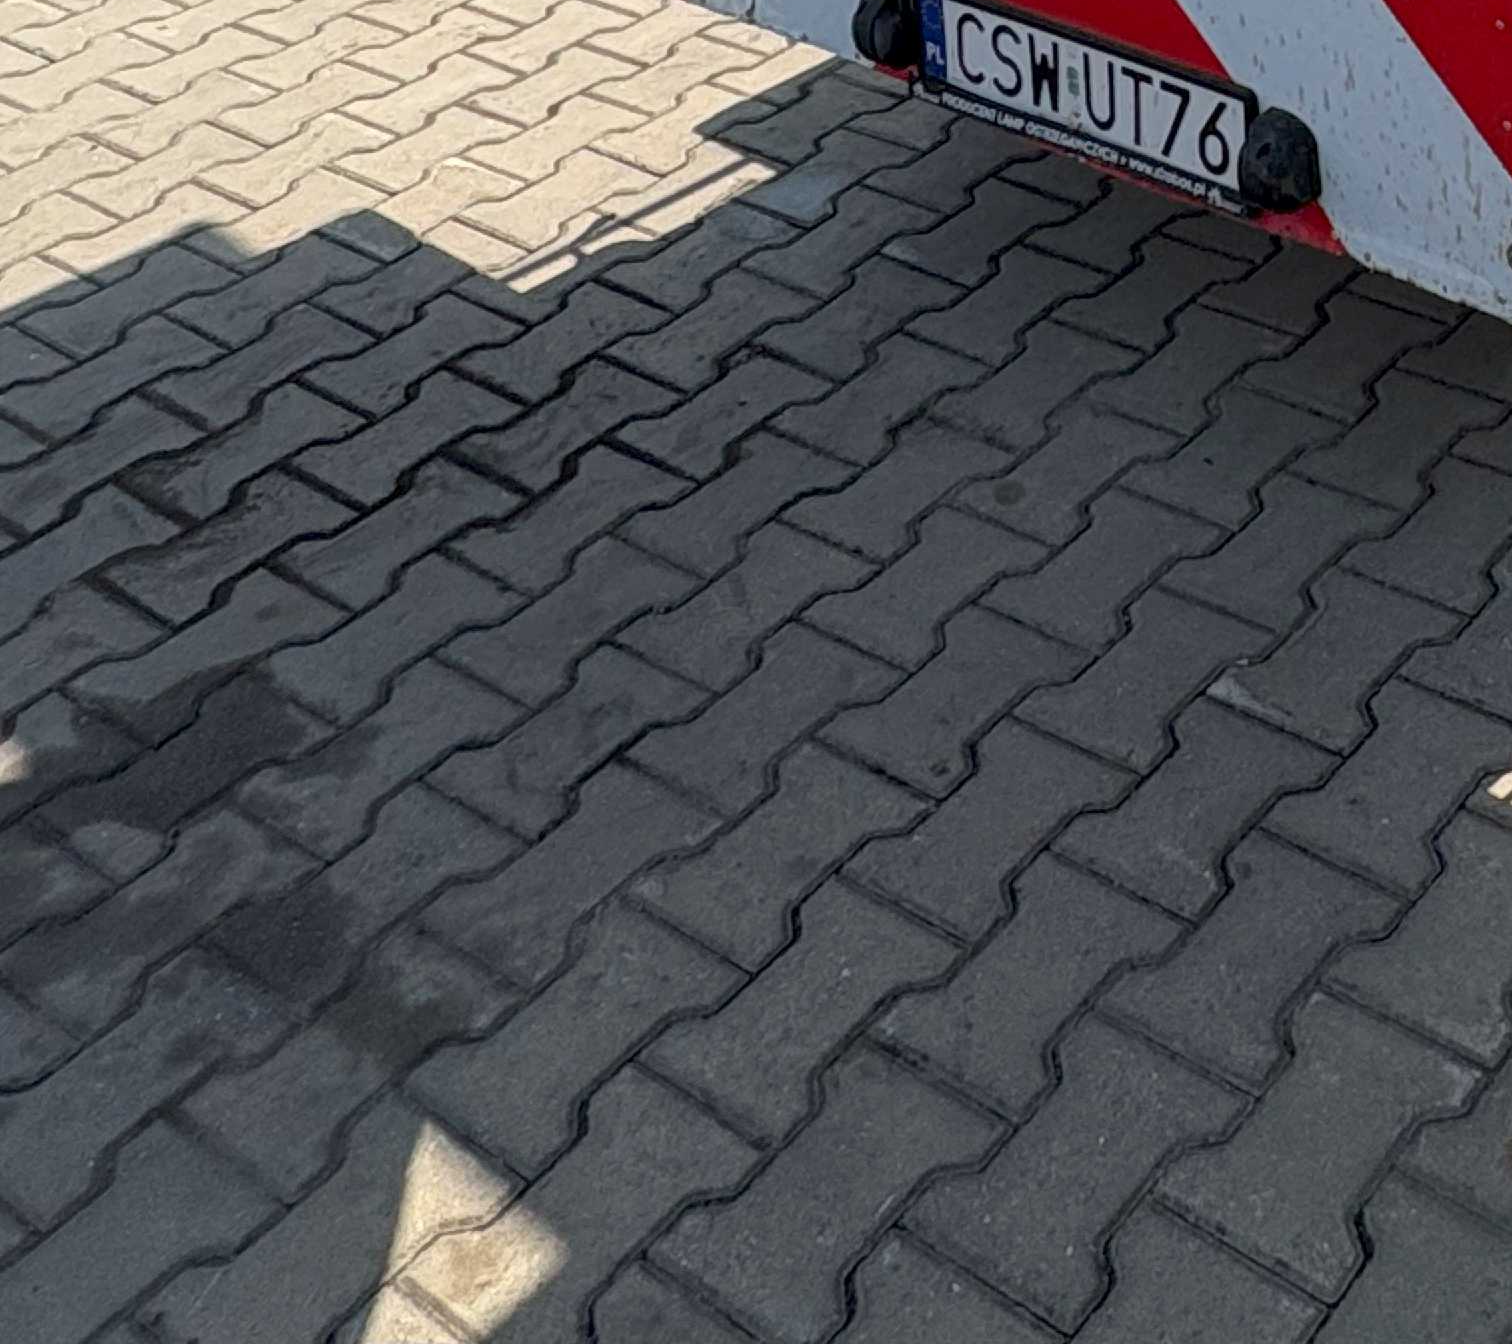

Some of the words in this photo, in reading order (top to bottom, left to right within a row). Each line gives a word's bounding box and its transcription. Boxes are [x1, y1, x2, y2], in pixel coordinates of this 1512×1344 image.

[925, 41, 945, 66] PL
[956, 12, 1060, 112] CSW
[1082, 51, 1231, 176] UT76
